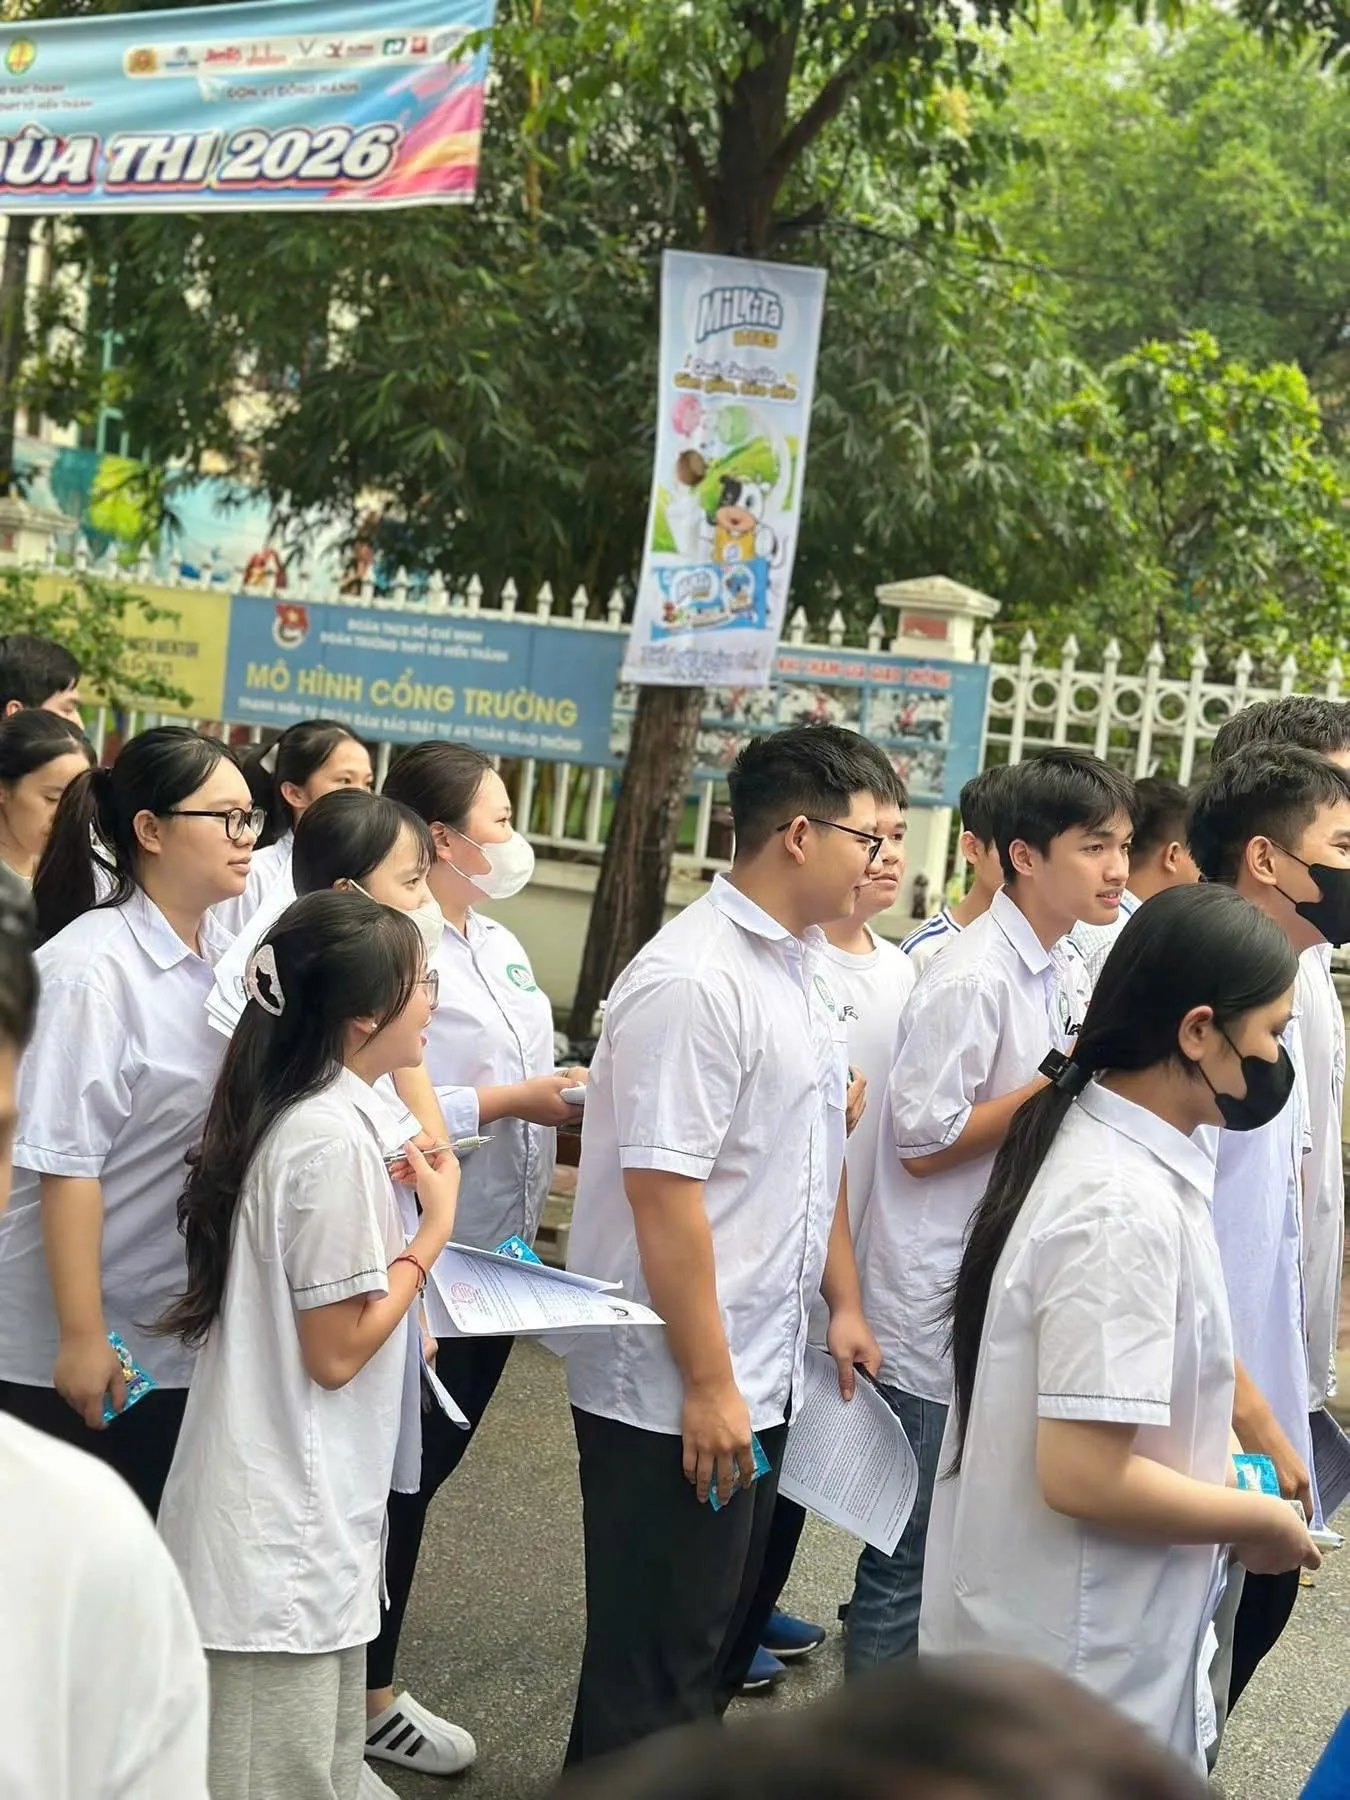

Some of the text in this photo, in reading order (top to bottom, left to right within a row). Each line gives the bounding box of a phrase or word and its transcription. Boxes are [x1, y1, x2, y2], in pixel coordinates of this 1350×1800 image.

[0, 123, 400, 188] ÙA THI 2026
[411, 621, 428, 638] HỒ
[430, 625, 452, 640] CHÍ
[246, 657, 577, 728] MÔ HÌNH CỔNG TRƯỜNG
